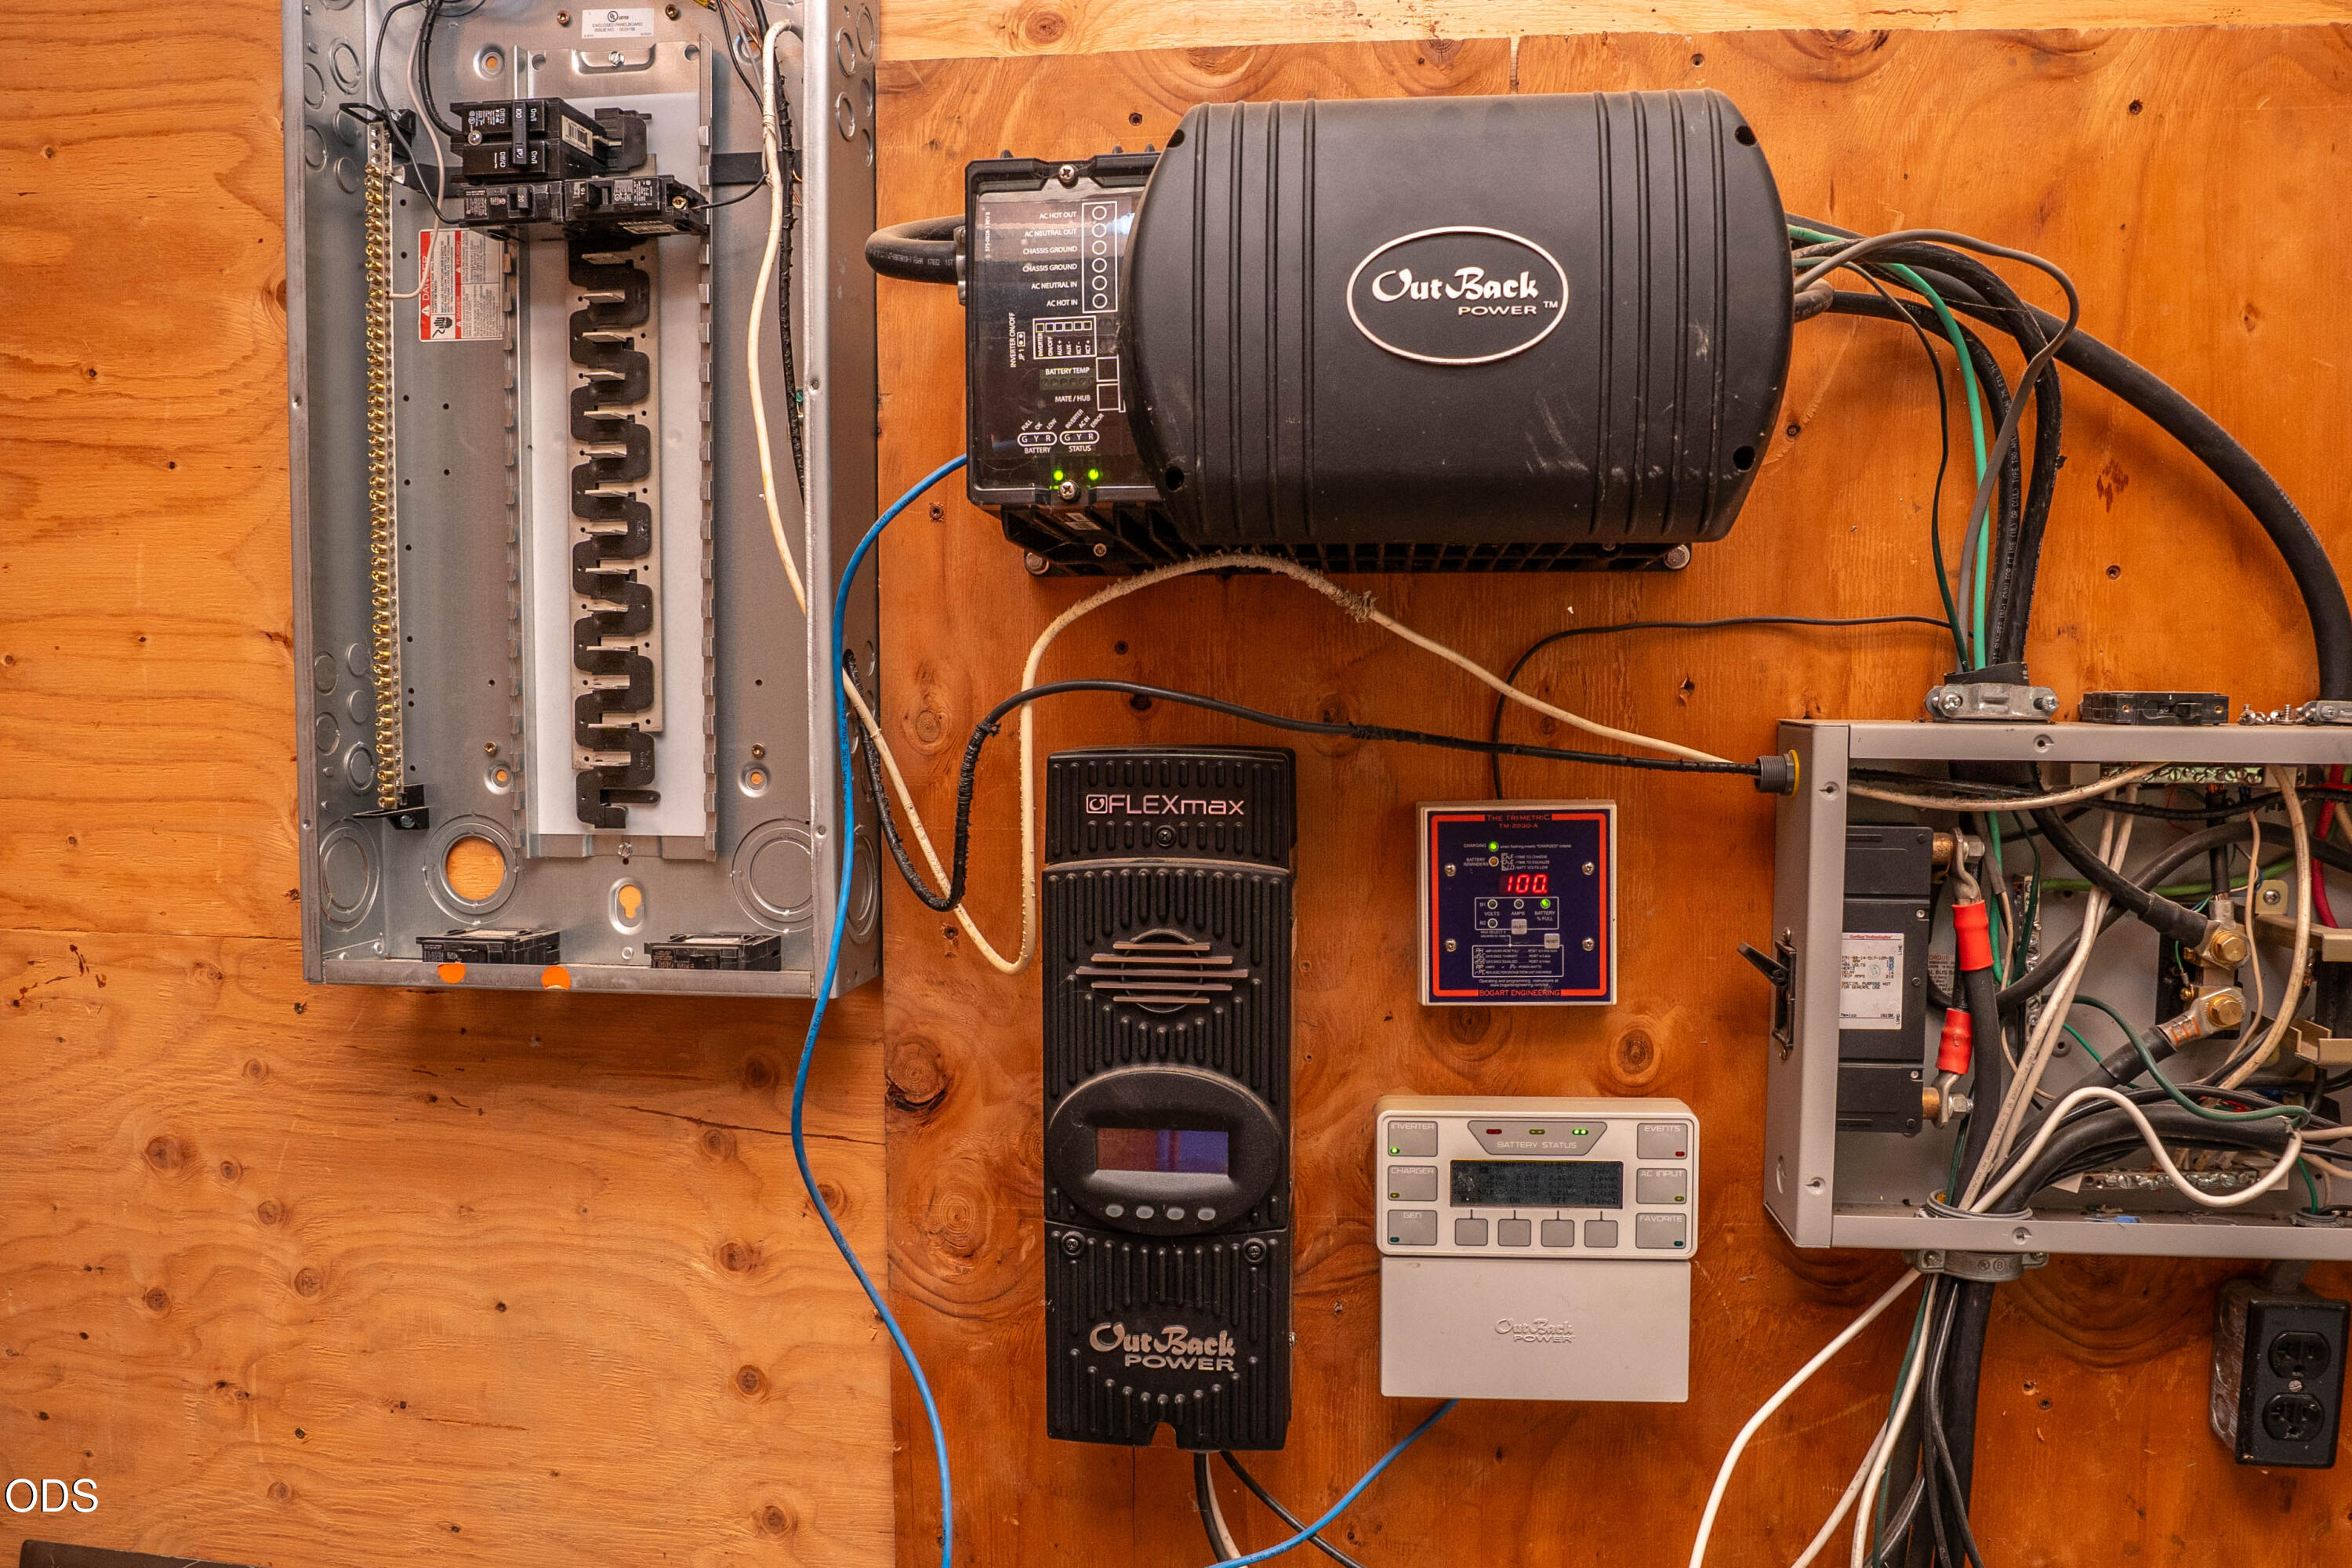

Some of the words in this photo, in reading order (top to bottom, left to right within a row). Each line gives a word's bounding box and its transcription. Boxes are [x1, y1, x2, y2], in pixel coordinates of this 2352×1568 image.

[1022, 264, 1049, 273] CHASSIS
[1049, 263, 1078, 271] GROUND
[1372, 267, 1539, 302] OutBack
[1457, 305, 1537, 315] POWER
[1018, 353, 1025, 361] JP
[1045, 367, 1073, 376] BATTERY
[1021, 419, 1033, 431] FULL
[1046, 417, 1058, 430] LOW
[1065, 408, 1084, 430] INVERTER
[1078, 420, 1087, 429] AC
[1090, 412, 1105, 429] ERROR
[1035, 421, 1044, 430] OK
[1109, 794, 1244, 815] FLEXmax
[1090, 1322, 1236, 1357] OutBack
[1513, 1334, 1573, 1343] POWER
[1124, 1354, 1235, 1372] POWER
